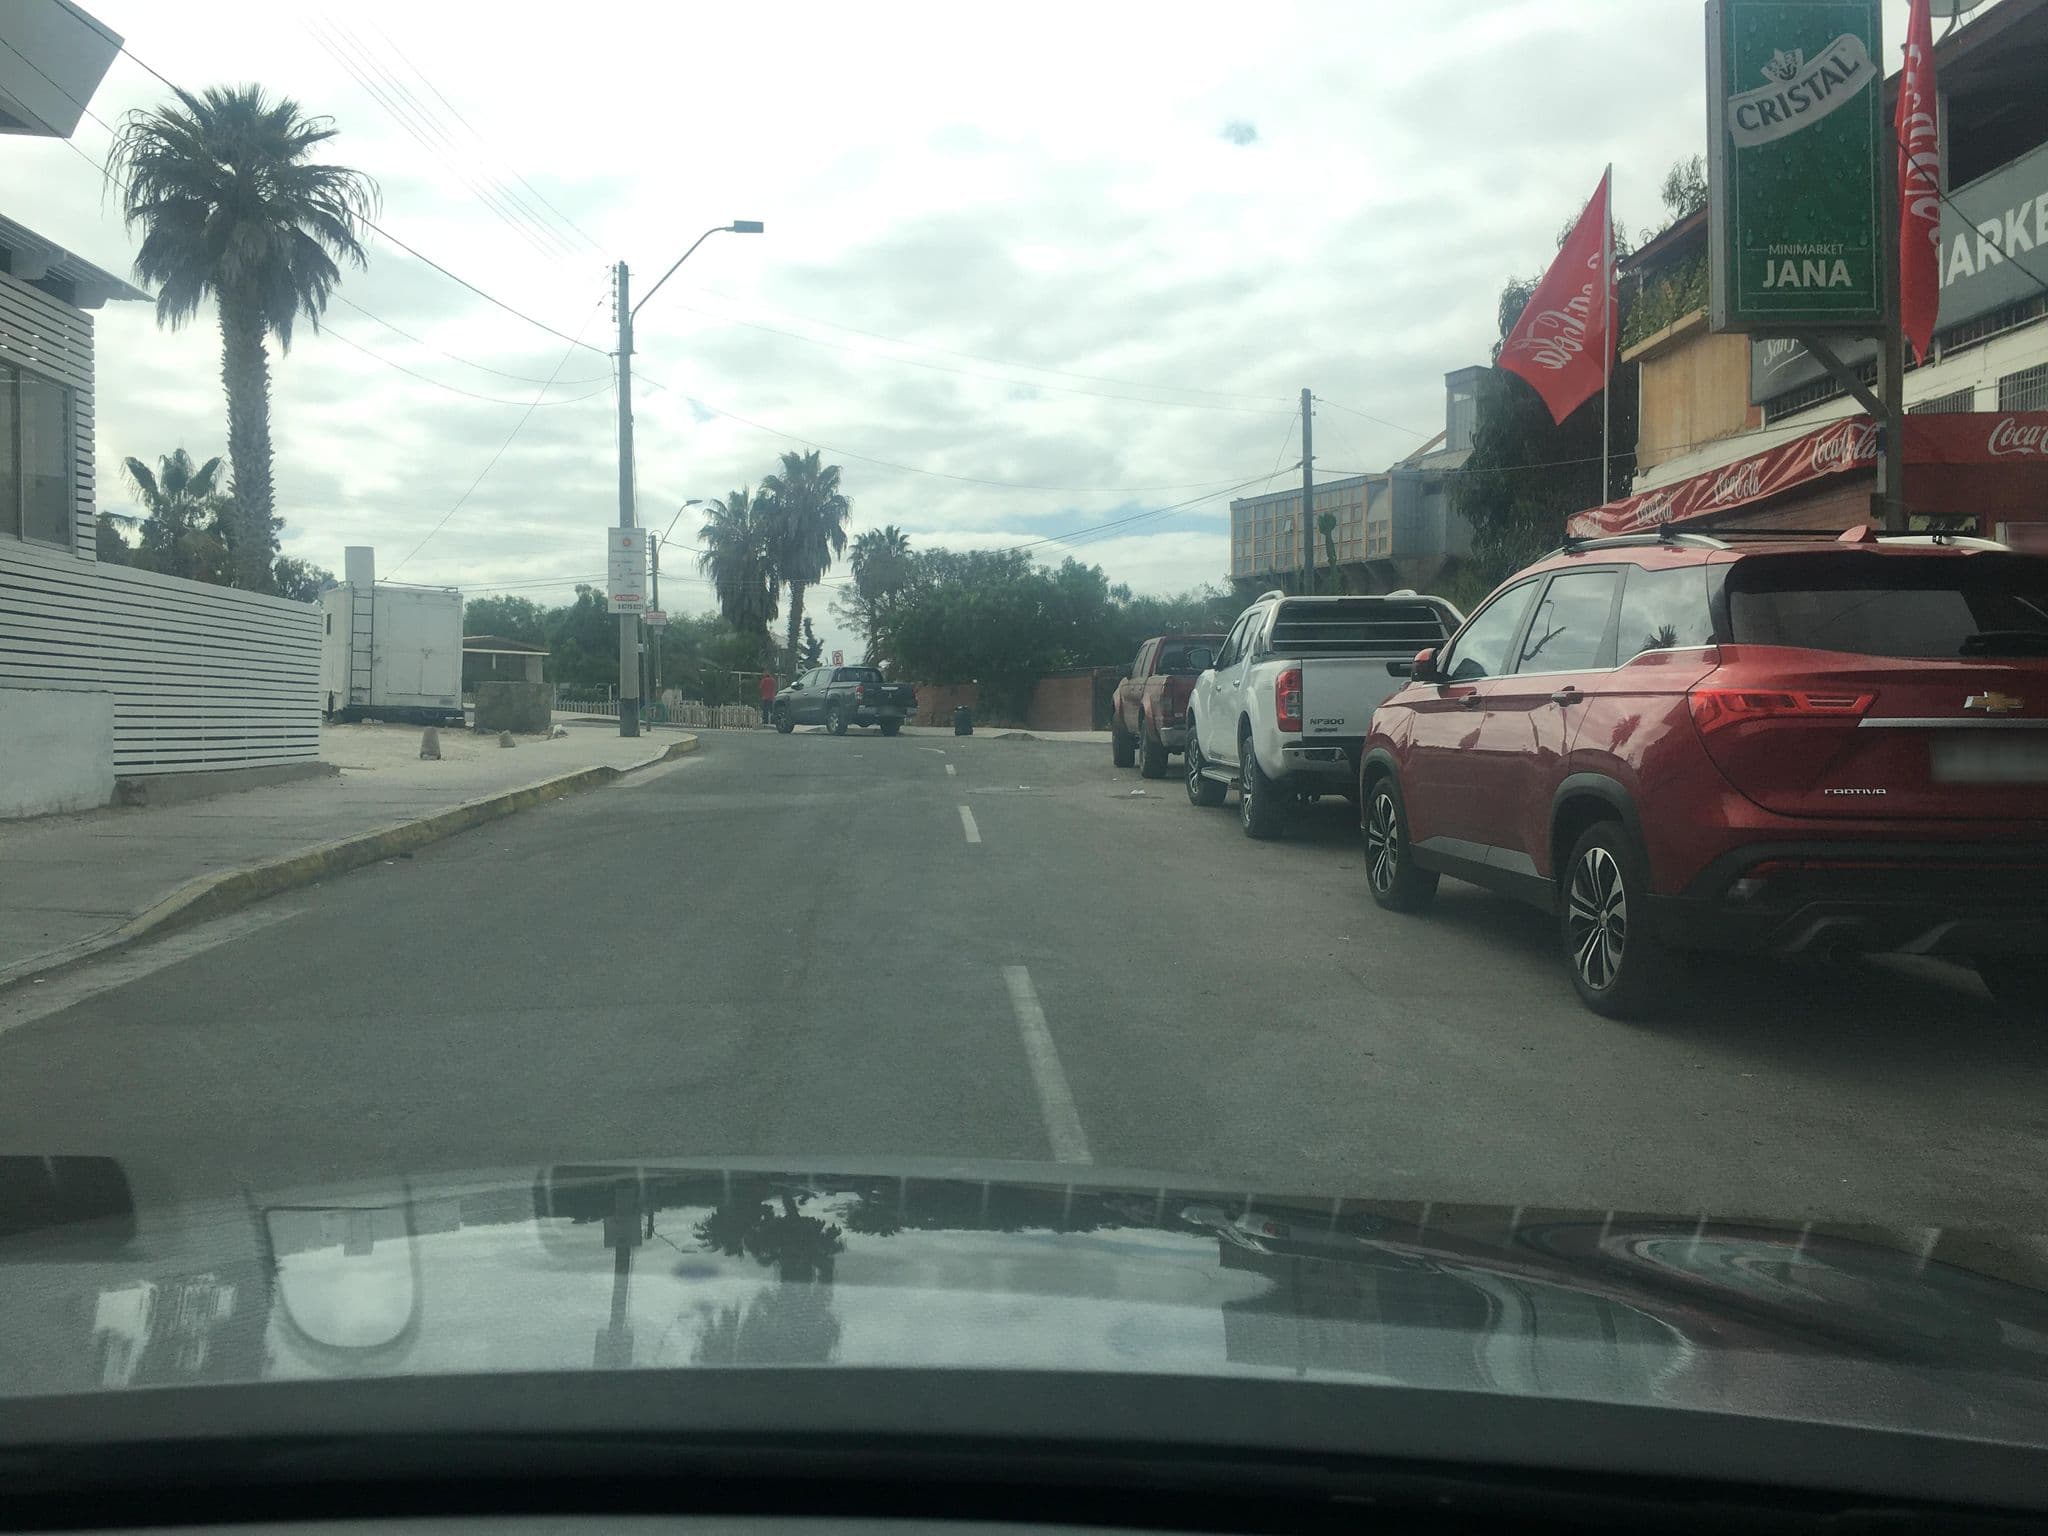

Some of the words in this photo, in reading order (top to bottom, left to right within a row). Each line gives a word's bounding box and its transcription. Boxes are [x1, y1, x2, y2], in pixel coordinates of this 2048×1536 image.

[1736, 55, 1860, 131] CRISTAL
[1769, 243, 1844, 256] MINIMARKET
[1938, 191, 2048, 292] ARKE
[1762, 259, 1853, 288] JANA
[1824, 787, 1887, 796] CAPTIVA
